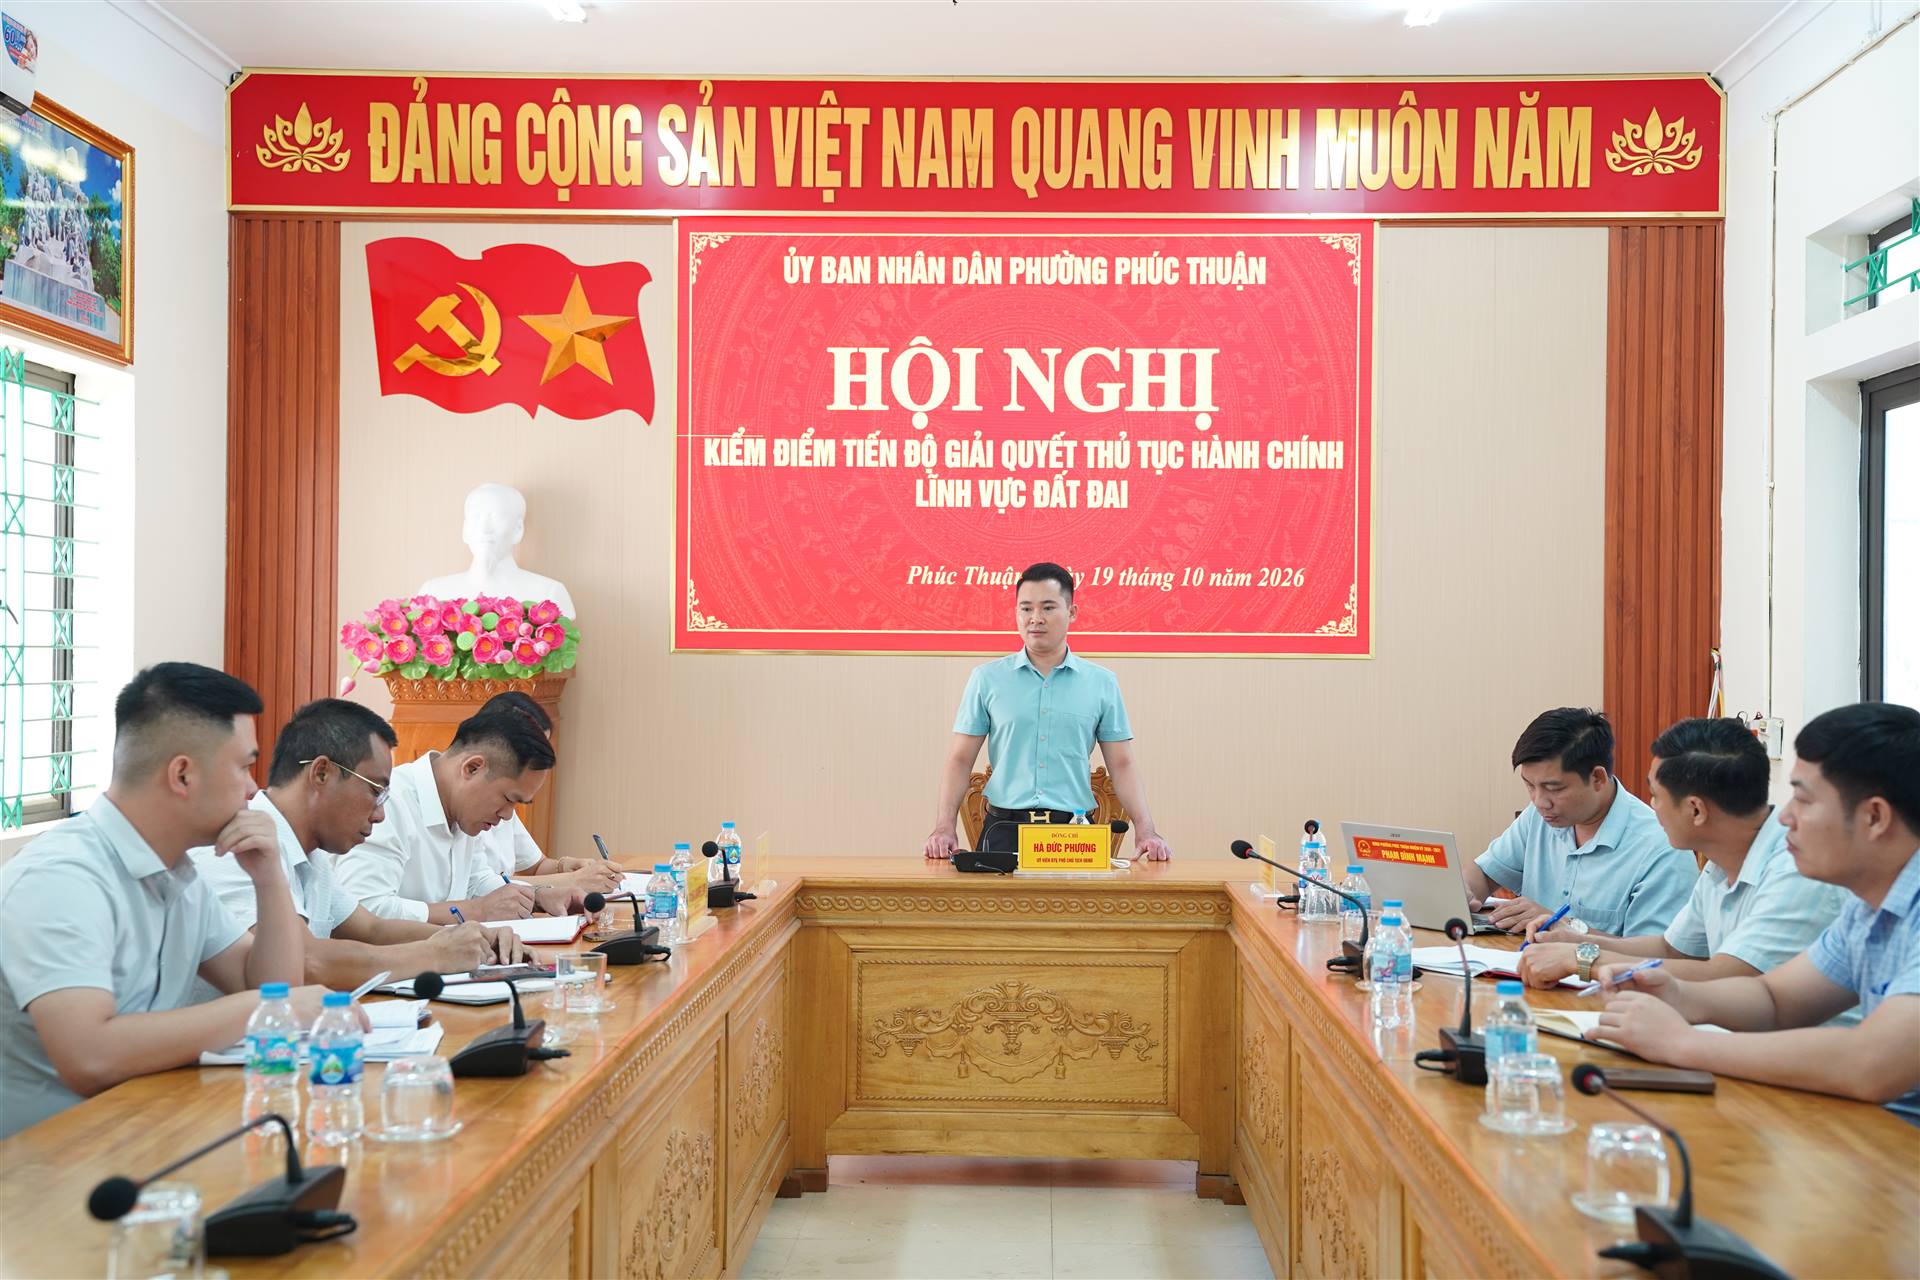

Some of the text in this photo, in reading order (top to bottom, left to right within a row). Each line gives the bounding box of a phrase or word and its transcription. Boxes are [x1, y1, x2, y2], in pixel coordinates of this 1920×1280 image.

[369, 77, 1592, 203] ĐẢNG CỘNG SẢN VIỆT NAM QUANG VINH MUÔN NĂM
[784, 246, 1266, 291] ỦY BAN NHÂN DÂN PHƯỜNG PHÚC THUẬN
[826, 336, 1220, 431] HỘI NGHỊ
[704, 427, 1343, 475] KIỂM ĐIỂM TIẾN ĐỘ GIẢI QUYẾT THỦ TỤC HÀNH CHÍNH
[916, 470, 1128, 514] LĨNH VỰC ĐẤT ĐAI
[907, 566, 957, 585] Phúc
[1091, 567, 1114, 586] 19
[1119, 567, 1175, 591] tháng
[1181, 567, 1204, 586] 10
[1209, 568, 1252, 586] năm
[1257, 568, 1304, 587] 2026
[1033, 841, 1096, 855] HÀ ĐỨC PHƯỢNG
